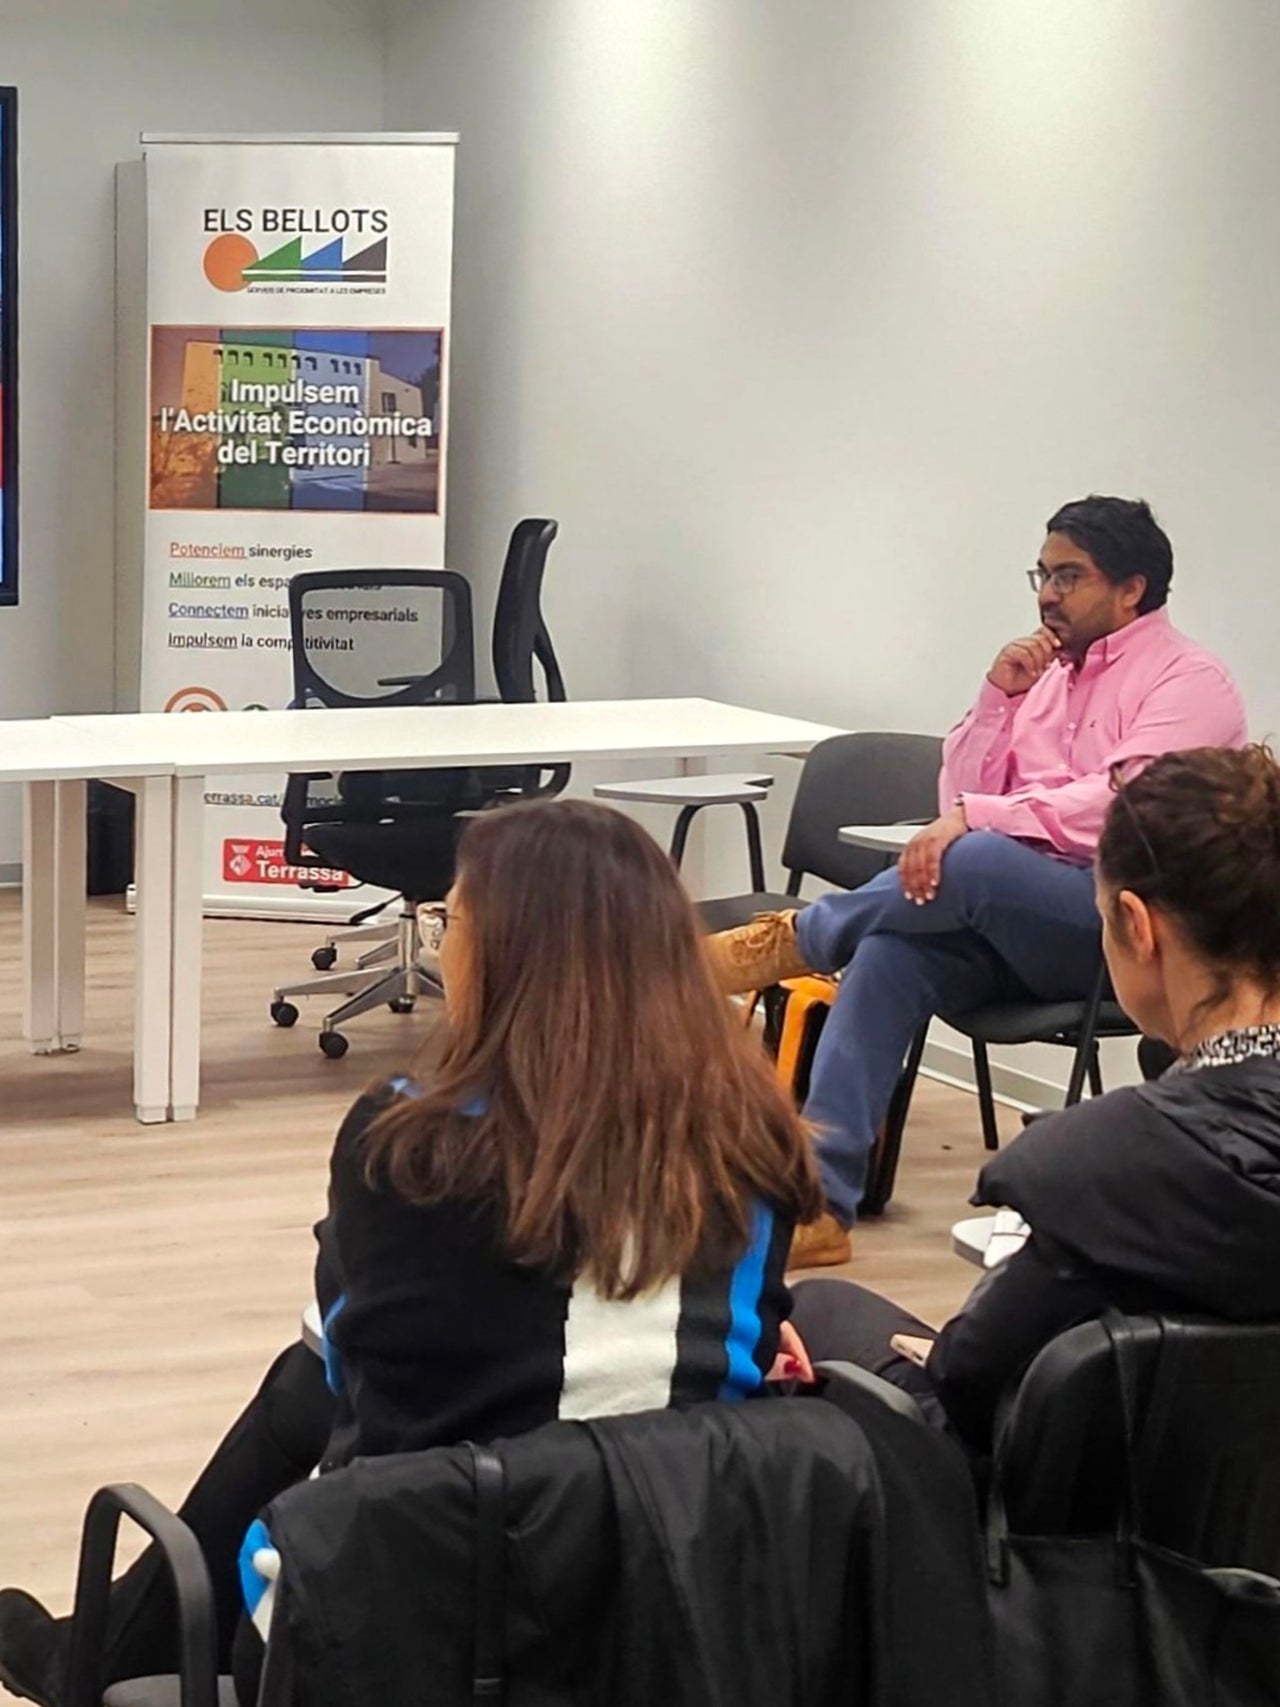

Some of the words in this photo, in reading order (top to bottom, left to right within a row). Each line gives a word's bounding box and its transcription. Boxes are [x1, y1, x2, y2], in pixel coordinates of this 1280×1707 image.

[204, 209, 253, 232] ELS
[262, 209, 388, 233] BELLOTS
[231, 379, 360, 408] Impulsem
[161, 408, 282, 434] l'Activitat
[288, 410, 433, 437] Econòmica
[217, 442, 258, 464] del
[269, 441, 370, 467] Territori
[170, 541, 246, 558] Potenciem
[248, 544, 313, 561] sinergies
[169, 571, 231, 588] Millorem
[235, 573, 256, 588] els
[258, 577, 290, 591] espa
[169, 602, 249, 619] Connectem
[326, 607, 419, 623] empresarials
[168, 632, 238, 649] Impulsem
[241, 632, 254, 648] la
[257, 634, 355, 652] comptitivitat
[256, 860, 344, 881] Terrassa
